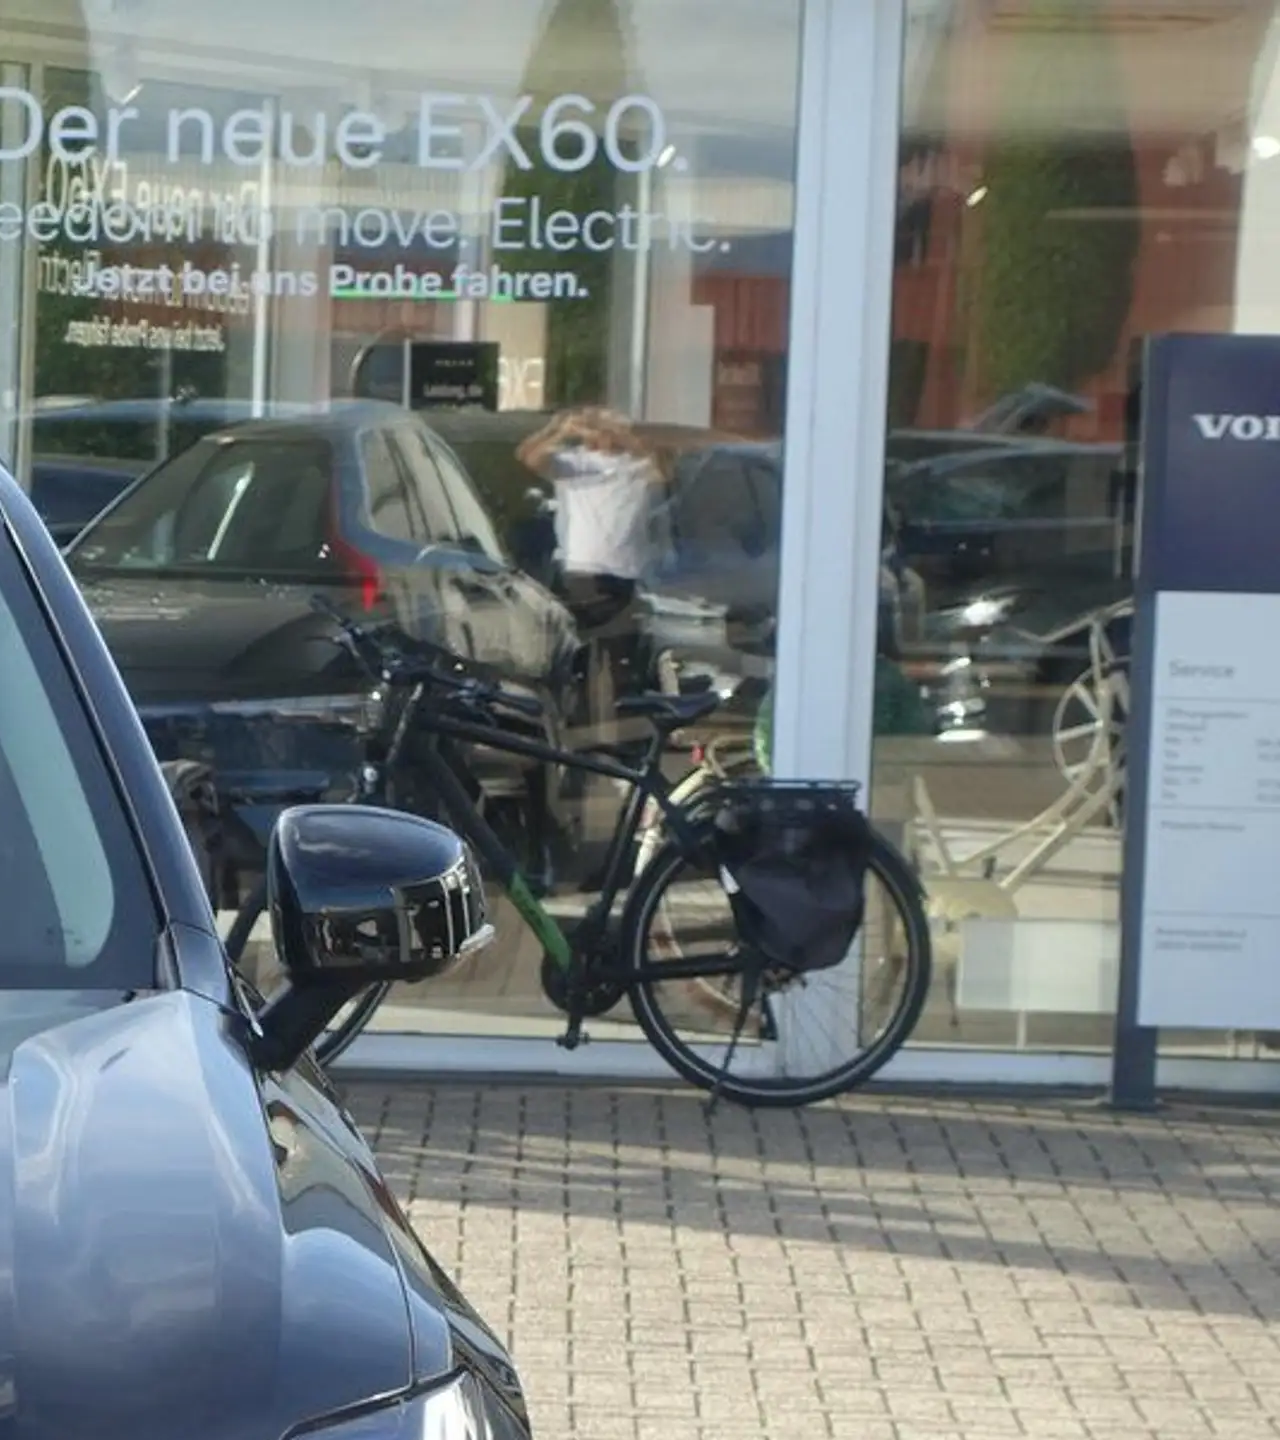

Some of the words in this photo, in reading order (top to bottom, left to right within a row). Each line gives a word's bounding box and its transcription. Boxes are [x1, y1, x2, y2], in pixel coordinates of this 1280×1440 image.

[167, 106, 386, 170] neue
[417, 92, 688, 173] EX60.
[295, 204, 468, 250] move.
[494, 196, 731, 254] Electric.
[73, 262, 173, 294] Jetzt
[183, 262, 240, 294] bei
[251, 270, 318, 296] uns
[330, 264, 442, 297] Probe
[452, 264, 589, 298] fahren.
